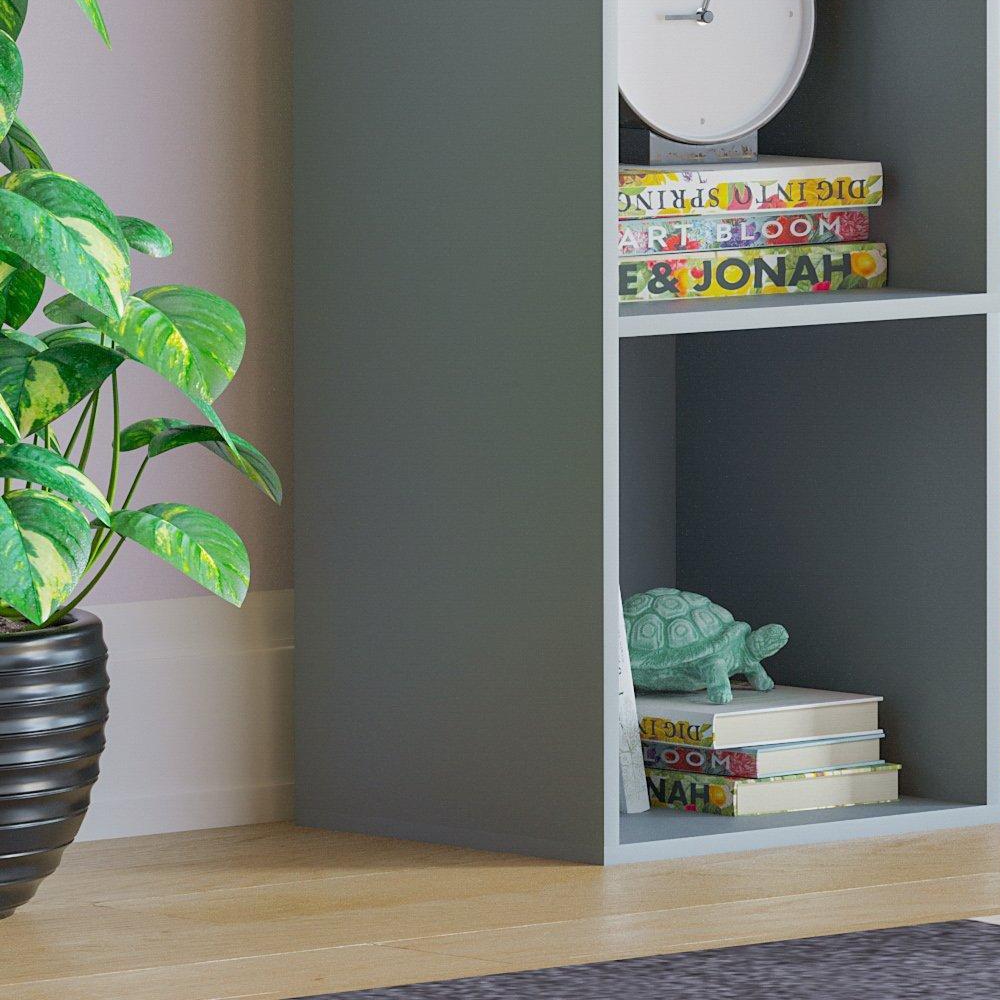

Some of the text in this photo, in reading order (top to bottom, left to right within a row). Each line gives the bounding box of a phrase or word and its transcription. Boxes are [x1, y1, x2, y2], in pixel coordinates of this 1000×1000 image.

[618, 179, 867, 212] DIG INTO SPRING
[618, 218, 842, 249] ART BLOOM
[693, 253, 852, 292] JONAH
[663, 721, 700, 741] DIG
